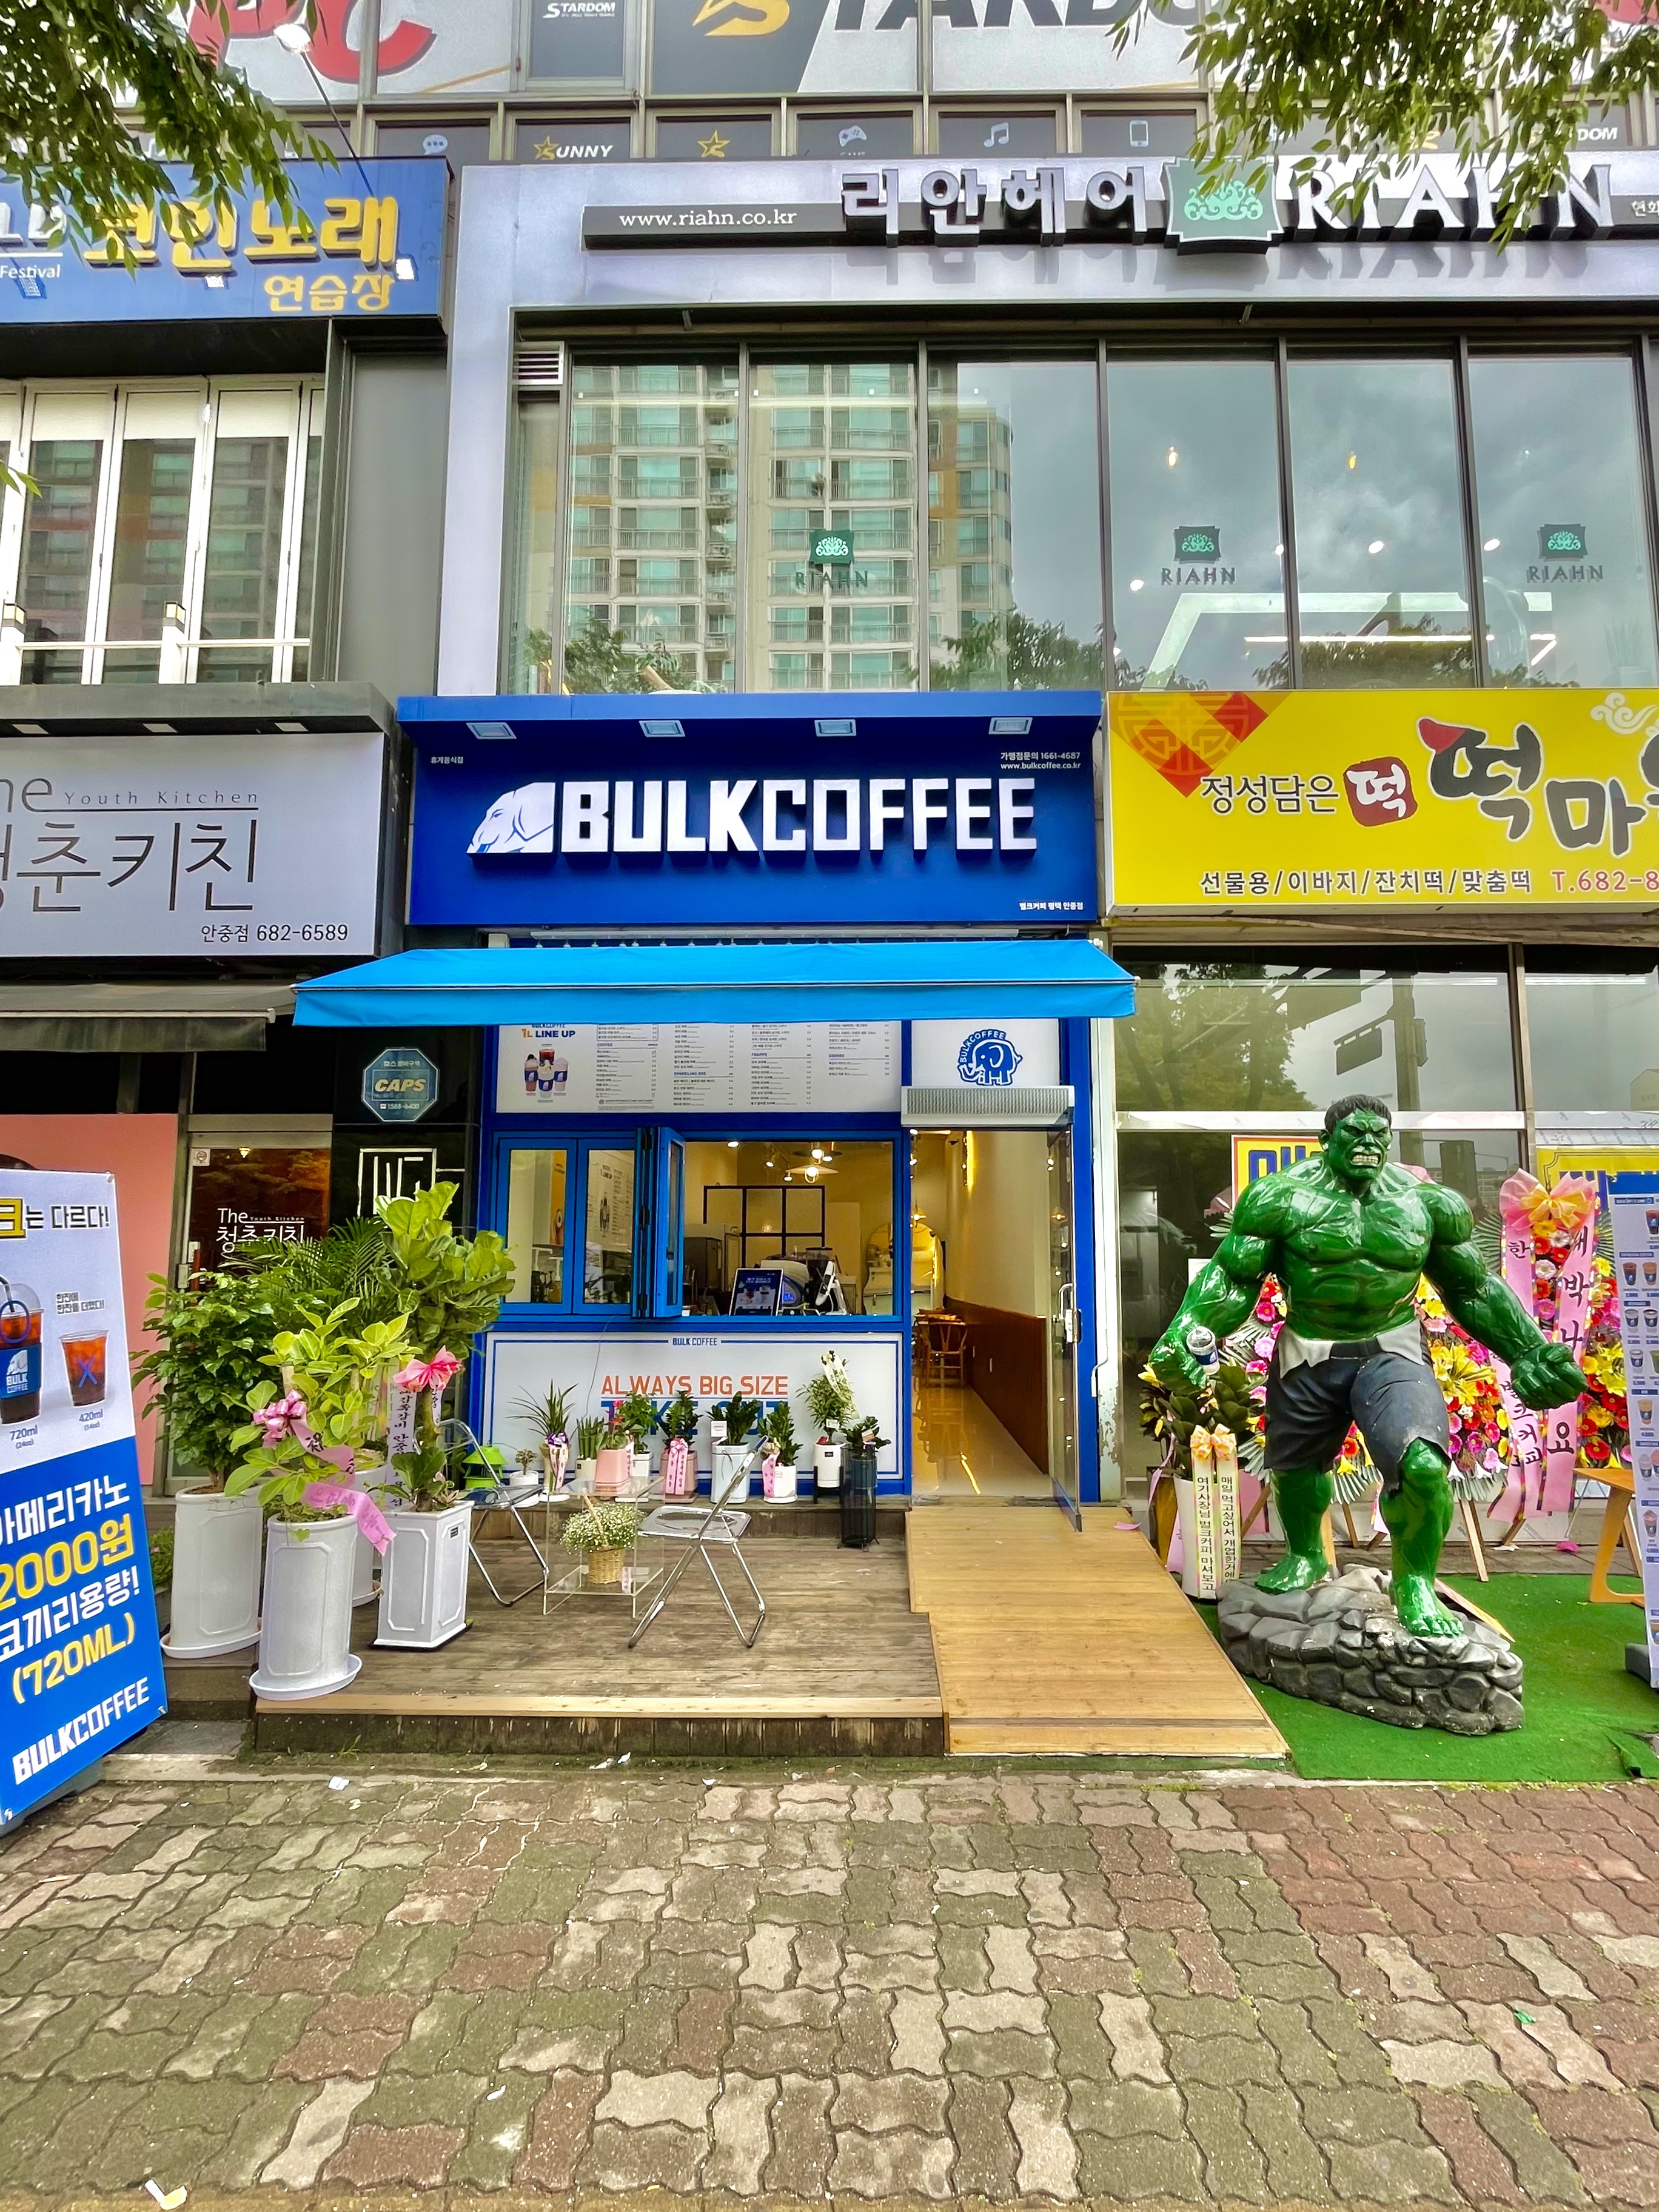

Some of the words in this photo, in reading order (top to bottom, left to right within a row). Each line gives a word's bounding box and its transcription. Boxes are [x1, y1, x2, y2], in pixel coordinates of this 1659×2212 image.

[543, 2, 616, 19] STARDOM
[841, 166, 1147, 235] 리안헤어
[619, 209, 797, 227] www.riahn.co.kr
[0, 264, 61, 278] Festival
[264, 275, 395, 312] 연습장
[796, 570, 868, 589] RIAHN
[1161, 567, 1235, 585] RIAHN
[1527, 565, 1603, 583] RIAHN
[1000, 761, 1081, 769] www.bulkcoffee.co.kr
[64, 791, 138, 805] Youth
[158, 791, 258, 805] Kitchen
[1199, 774, 1339, 814] 정성담은
[1346, 763, 1411, 819] 떡
[561, 778, 1037, 853] BULKCOFFEE
[0, 819, 257, 913] 춘키친
[201, 924, 249, 943] 안중점
[256, 924, 348, 942] 682-6589
[959, 1030, 1005, 1063] BULKCOFFEE
[374, 1079, 427, 1092] CAPS
[51, 1205, 110, 1228] 다르다!
[217, 1208, 249, 1224] The
[6, 1372, 28, 1386] BULK
[6, 1382, 28, 1394] COFFEE
[601, 1375, 692, 1395] ALWAYS
[700, 1375, 732, 1395] BIG
[740, 1375, 788, 1395] SIZE
[79, 1409, 103, 1423] 420ml
[10, 1425, 38, 1441] 720ml
[1221, 1476, 1233, 1493] 매일
[1198, 1476, 1211, 1518] 여기사장님
[1199, 1520, 1213, 1555] 벌크커피
[1201, 1557, 1215, 1591] 마셔보고
[12, 1612, 135, 1704] (720ML)
[12, 1676, 150, 1785] BULKCOFFEE
